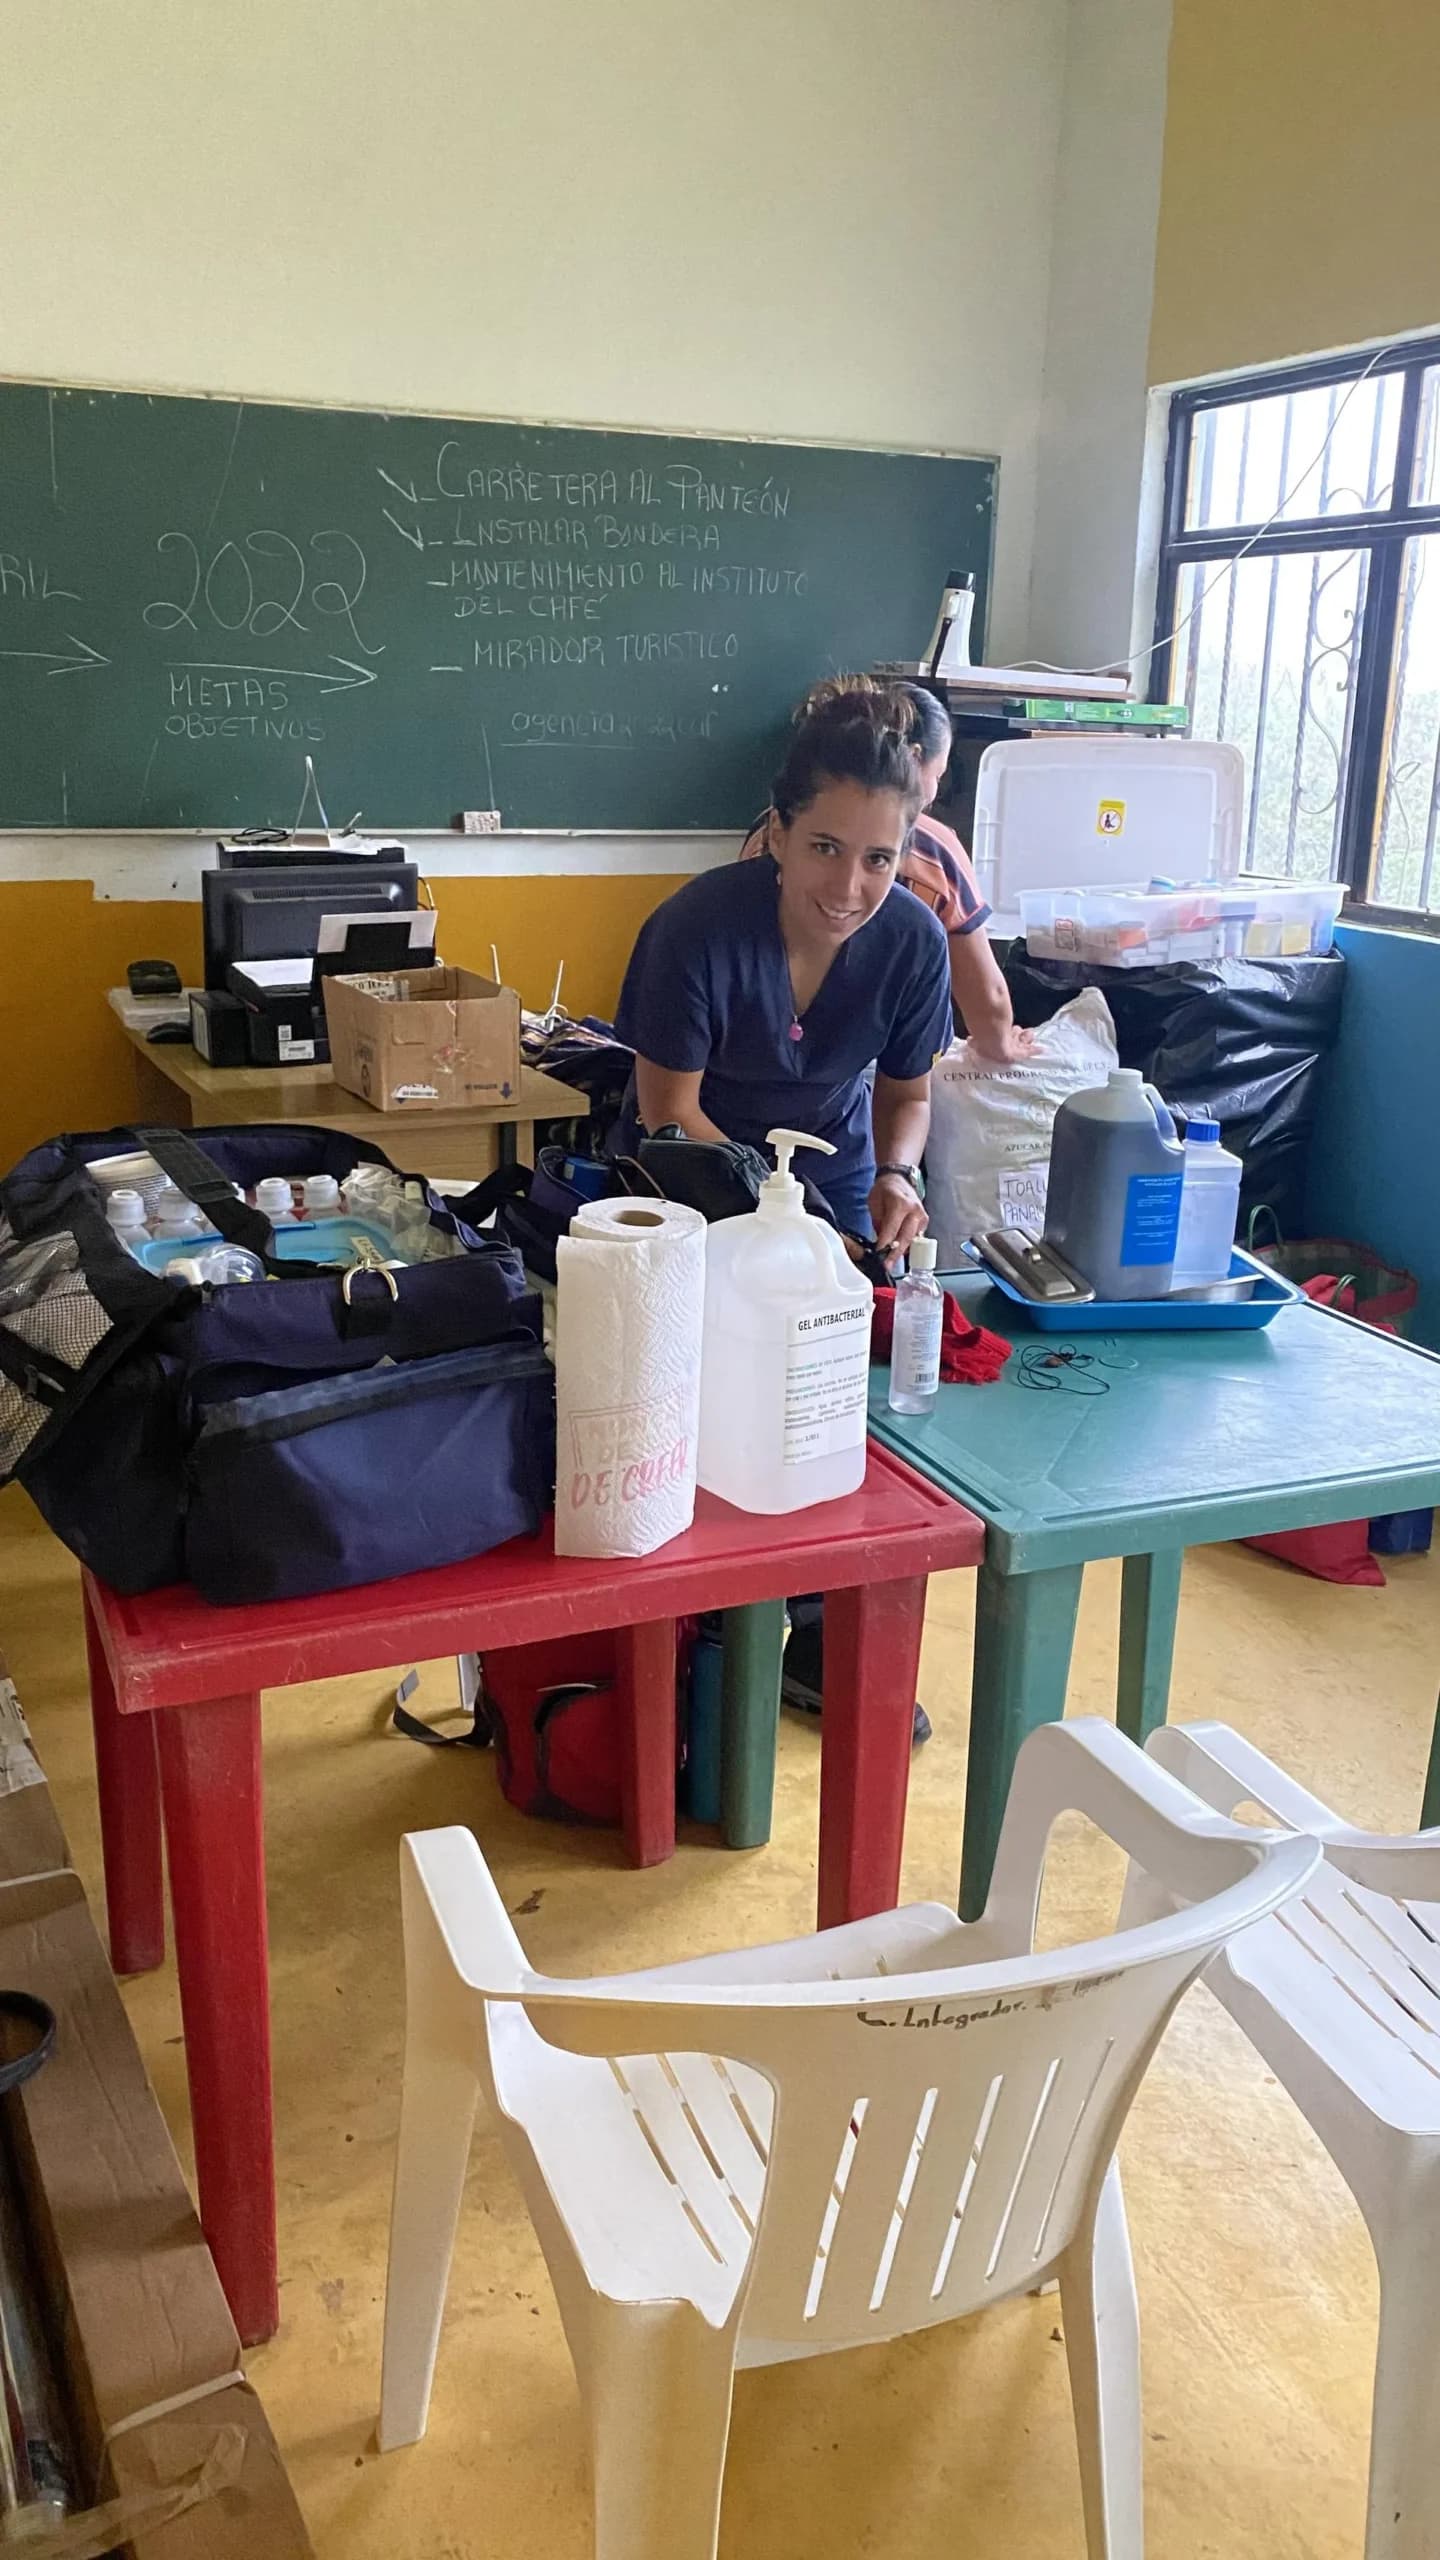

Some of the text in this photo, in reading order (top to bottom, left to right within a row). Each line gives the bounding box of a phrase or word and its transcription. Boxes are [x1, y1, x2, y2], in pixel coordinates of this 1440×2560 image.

[436, 440, 617, 504] CARRETERA
[629, 468, 662, 504] AL
[595, 513, 721, 551] BANDERA
[142, 529, 387, 654] 2022
[450, 558, 809, 596] MANTENIMIENTO AL INSTITUTO
[454, 597, 514, 618] DEL
[473, 634, 606, 669] MIRADOR
[170, 671, 289, 710] METAS
[164, 712, 326, 741] OBJETIVOS
[943, 1071, 996, 1082] CENTRAL
[798, 1307, 866, 1331] GEL ANTIBACTERIAL
